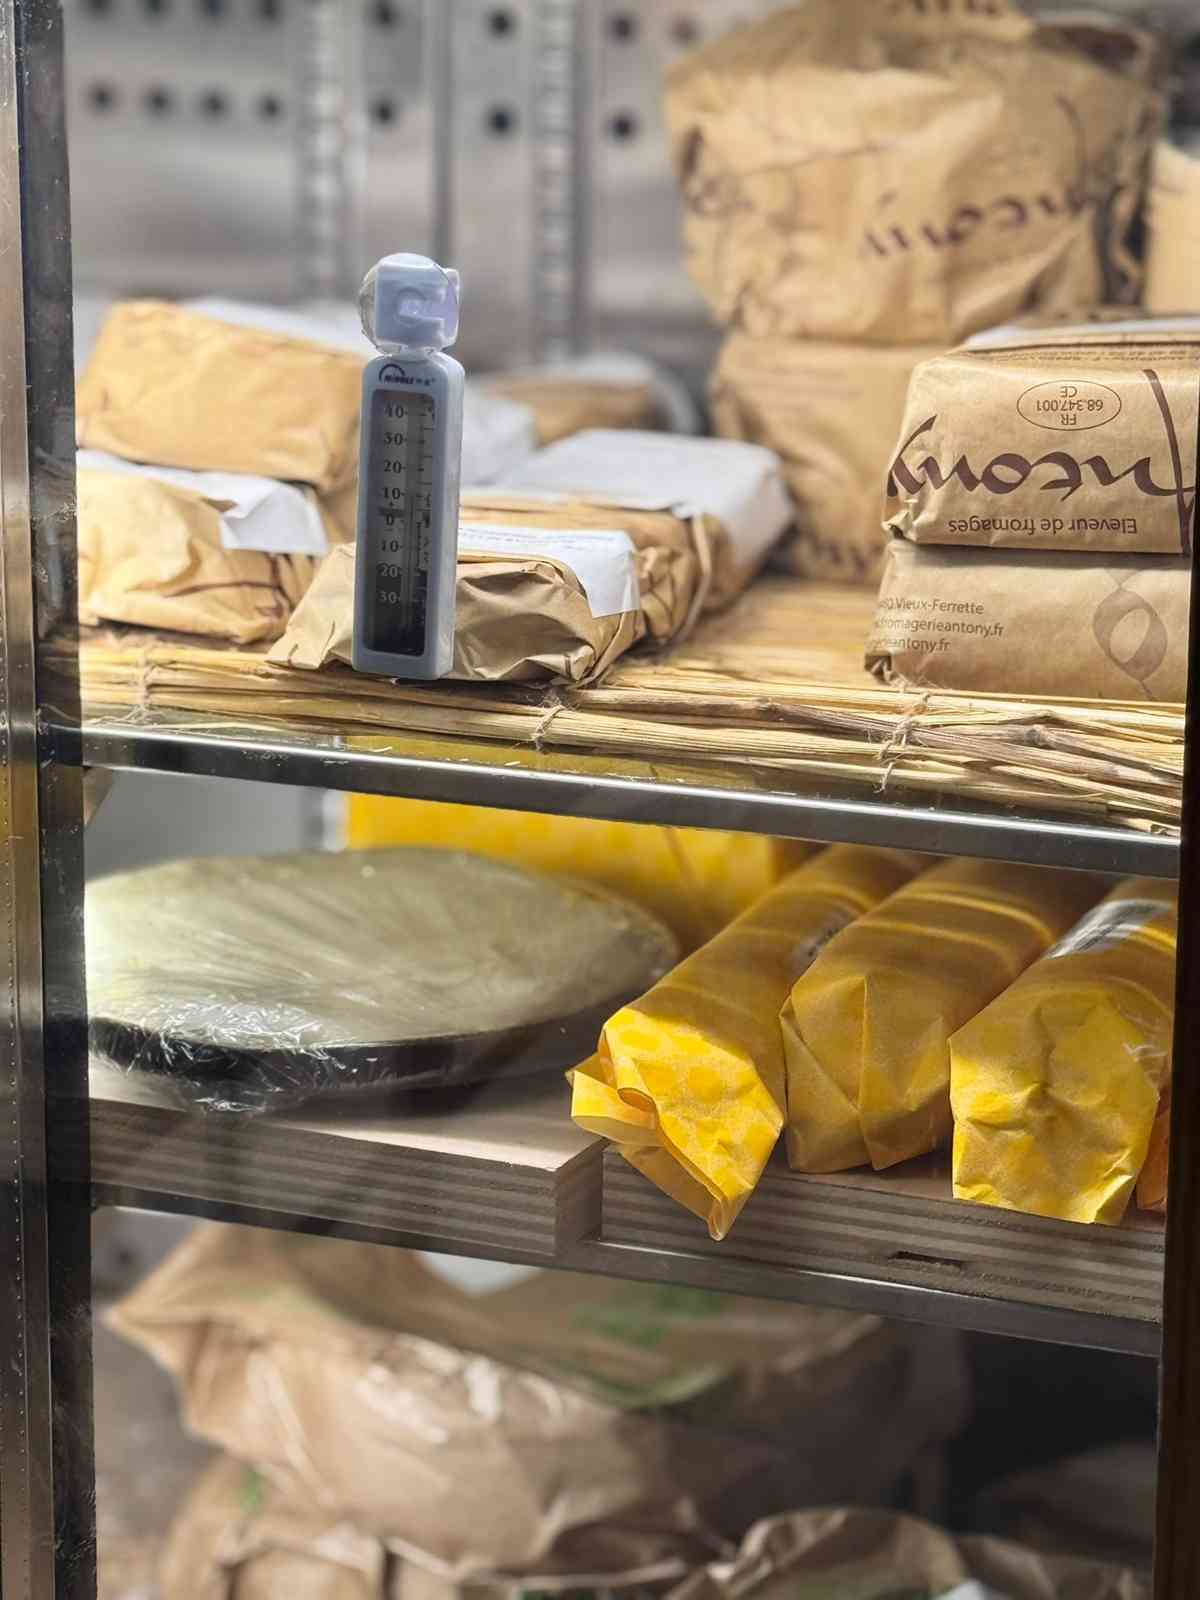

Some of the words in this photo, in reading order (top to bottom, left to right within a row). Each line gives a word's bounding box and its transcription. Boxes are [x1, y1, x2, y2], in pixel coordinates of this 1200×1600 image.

[1059, 385, 1078, 398] CE
[1035, 399, 1104, 412] 68.347.001
[1060, 413, 1077, 425] FR
[383, 459, 403, 474] 20
[383, 487, 401, 500] 10
[948, 516, 1037, 535] fromages
[1040, 518, 1064, 534] de
[1069, 518, 1137, 534] Eleveur
[381, 540, 399, 553] 10
